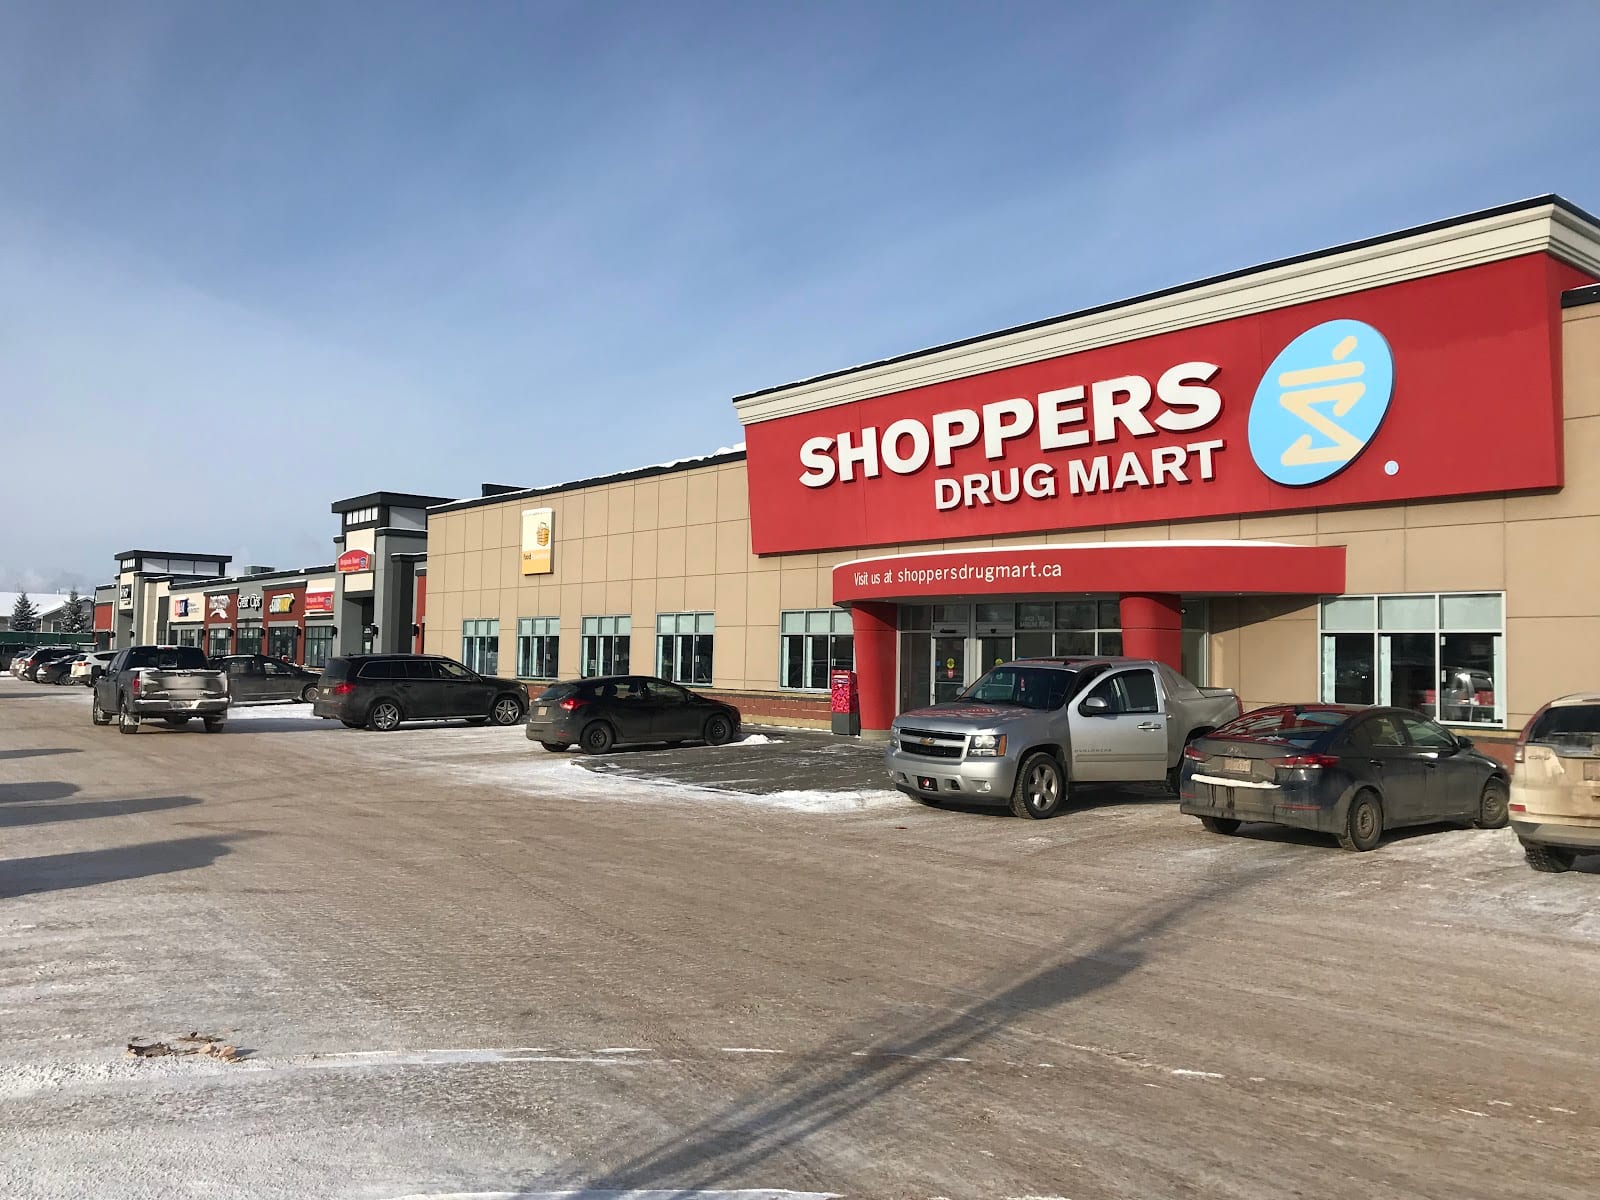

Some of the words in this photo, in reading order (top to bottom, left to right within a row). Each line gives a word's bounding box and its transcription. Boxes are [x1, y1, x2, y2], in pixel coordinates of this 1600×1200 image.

[798, 361, 1222, 488] SHOPPERS
[934, 463, 1056, 510] DRUG
[1068, 439, 1224, 495] MART
[853, 571, 869, 586] Visit
[871, 573, 881, 585] us
[883, 570, 893, 584] at
[897, 561, 1062, 584] shoppersdrugmart.ca
